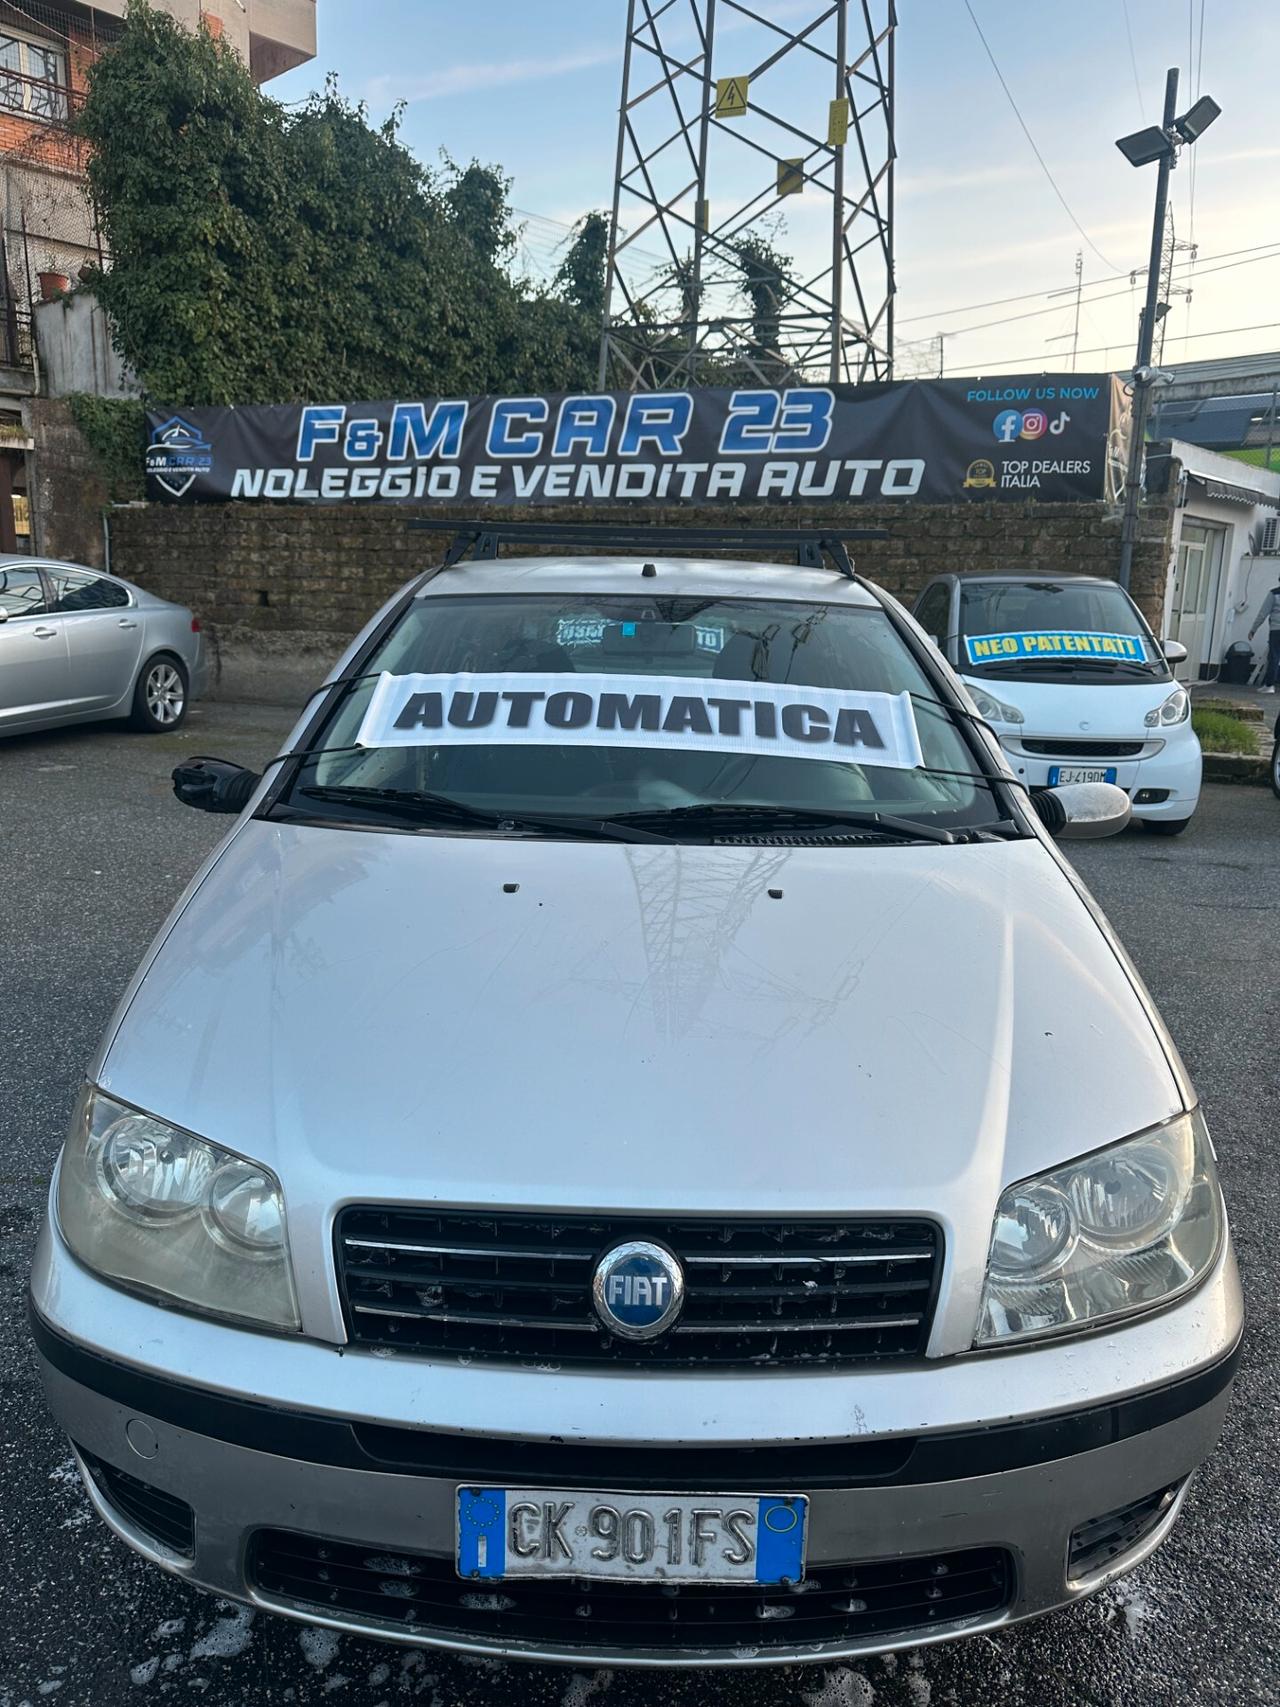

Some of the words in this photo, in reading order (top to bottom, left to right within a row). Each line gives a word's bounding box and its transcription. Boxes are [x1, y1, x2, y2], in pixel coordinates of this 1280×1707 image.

[967, 388, 1031, 402] FOLLOW
[1035, 387, 1055, 399] US
[1060, 387, 1100, 399] NOW
[296, 400, 469, 461] F&M
[485, 392, 694, 458] CAR
[718, 387, 836, 455] 23
[230, 465, 461, 498] NOLEGGIO
[470, 465, 502, 498] E
[512, 462, 747, 498] VENDITA
[757, 458, 926, 497] AUTO
[1002, 460, 1031, 474] TOP
[1032, 460, 1091, 474] DEALERS
[1000, 474, 1041, 488] ITALIA
[974, 637, 1018, 656] NEO
[1022, 635, 1136, 655] PATENTATI
[393, 690, 885, 749] AUTOMATICA
[608, 1275, 668, 1306] FIAT
